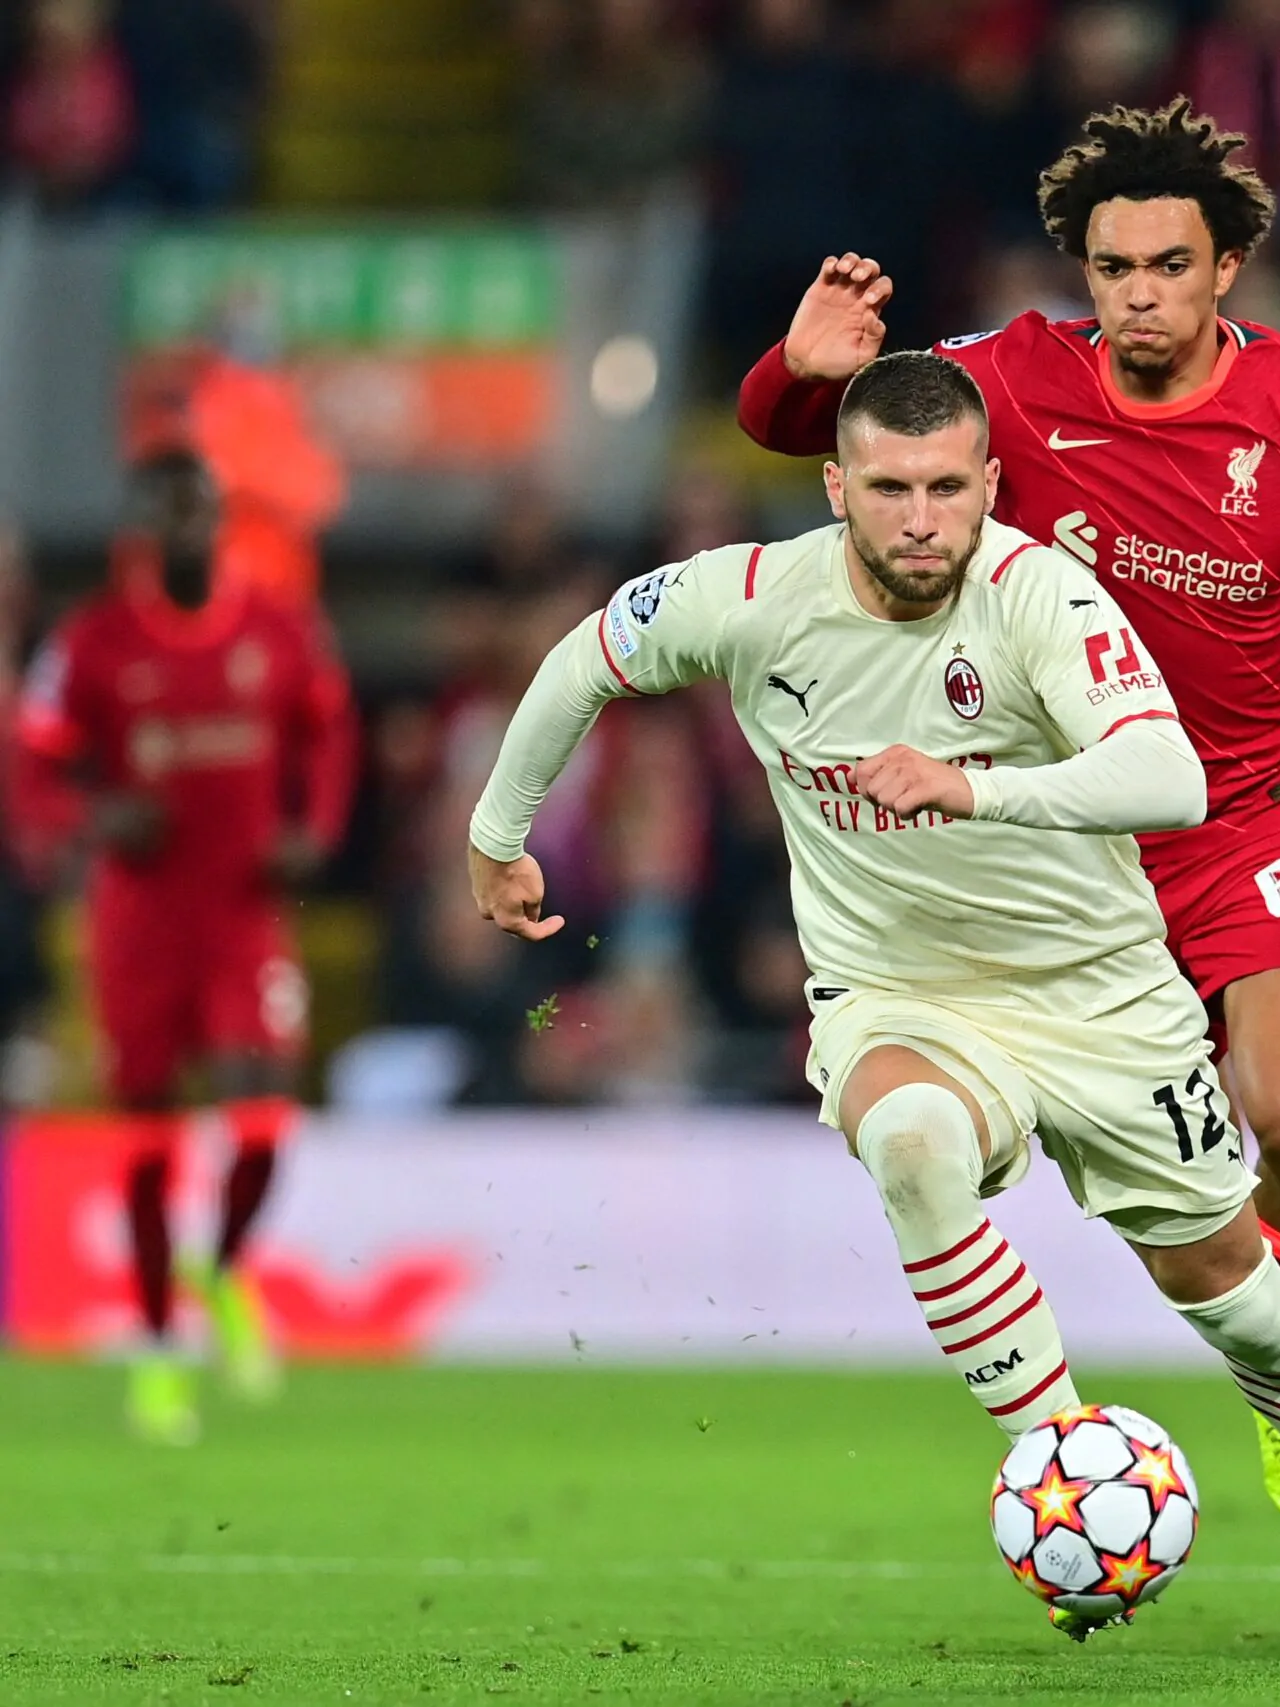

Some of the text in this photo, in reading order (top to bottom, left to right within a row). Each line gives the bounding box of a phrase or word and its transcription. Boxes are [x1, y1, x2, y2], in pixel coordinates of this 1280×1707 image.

[1113, 534, 1263, 582] standard
[1111, 559, 1268, 602] chartered
[819, 801, 860, 832] FLY
[1153, 1068, 1225, 1163] 12
[965, 1347, 1025, 1385] ACM
